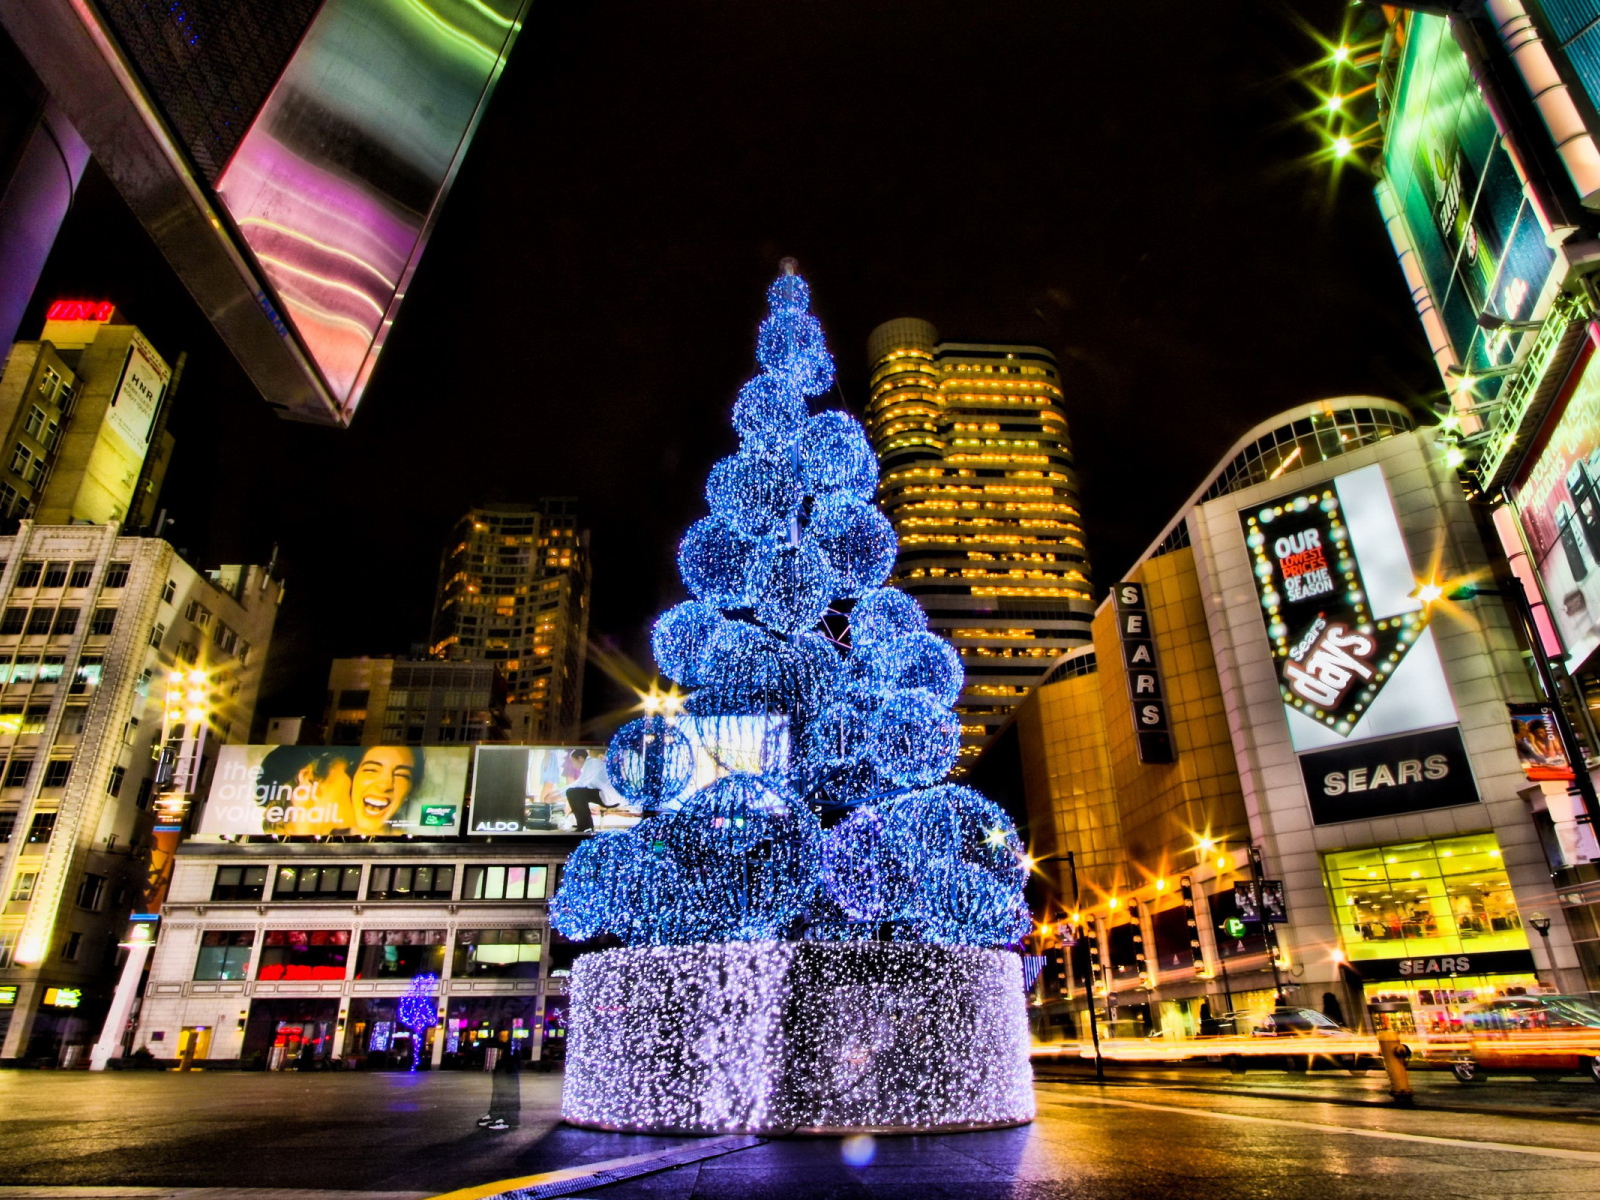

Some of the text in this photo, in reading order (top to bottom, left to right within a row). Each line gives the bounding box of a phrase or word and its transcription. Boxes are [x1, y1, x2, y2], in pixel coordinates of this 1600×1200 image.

[131, 373, 153, 401] HNR
[1275, 528, 1321, 558] OUR
[1279, 546, 1322, 568] LOWEST
[1282, 557, 1327, 579] PRICES
[1285, 568, 1329, 590] OF THE
[1288, 579, 1333, 601] SEASON
[1121, 586, 1160, 725] SEARS
[1287, 626, 1372, 706] days
[1541, 706, 1556, 741] DINING
[223, 762, 265, 780] the
[1323, 754, 1449, 796] SEARS
[218, 781, 321, 805] original
[215, 803, 344, 823] voicemail.
[476, 821, 519, 831] ALDO
[1399, 956, 1470, 975] SEARS
